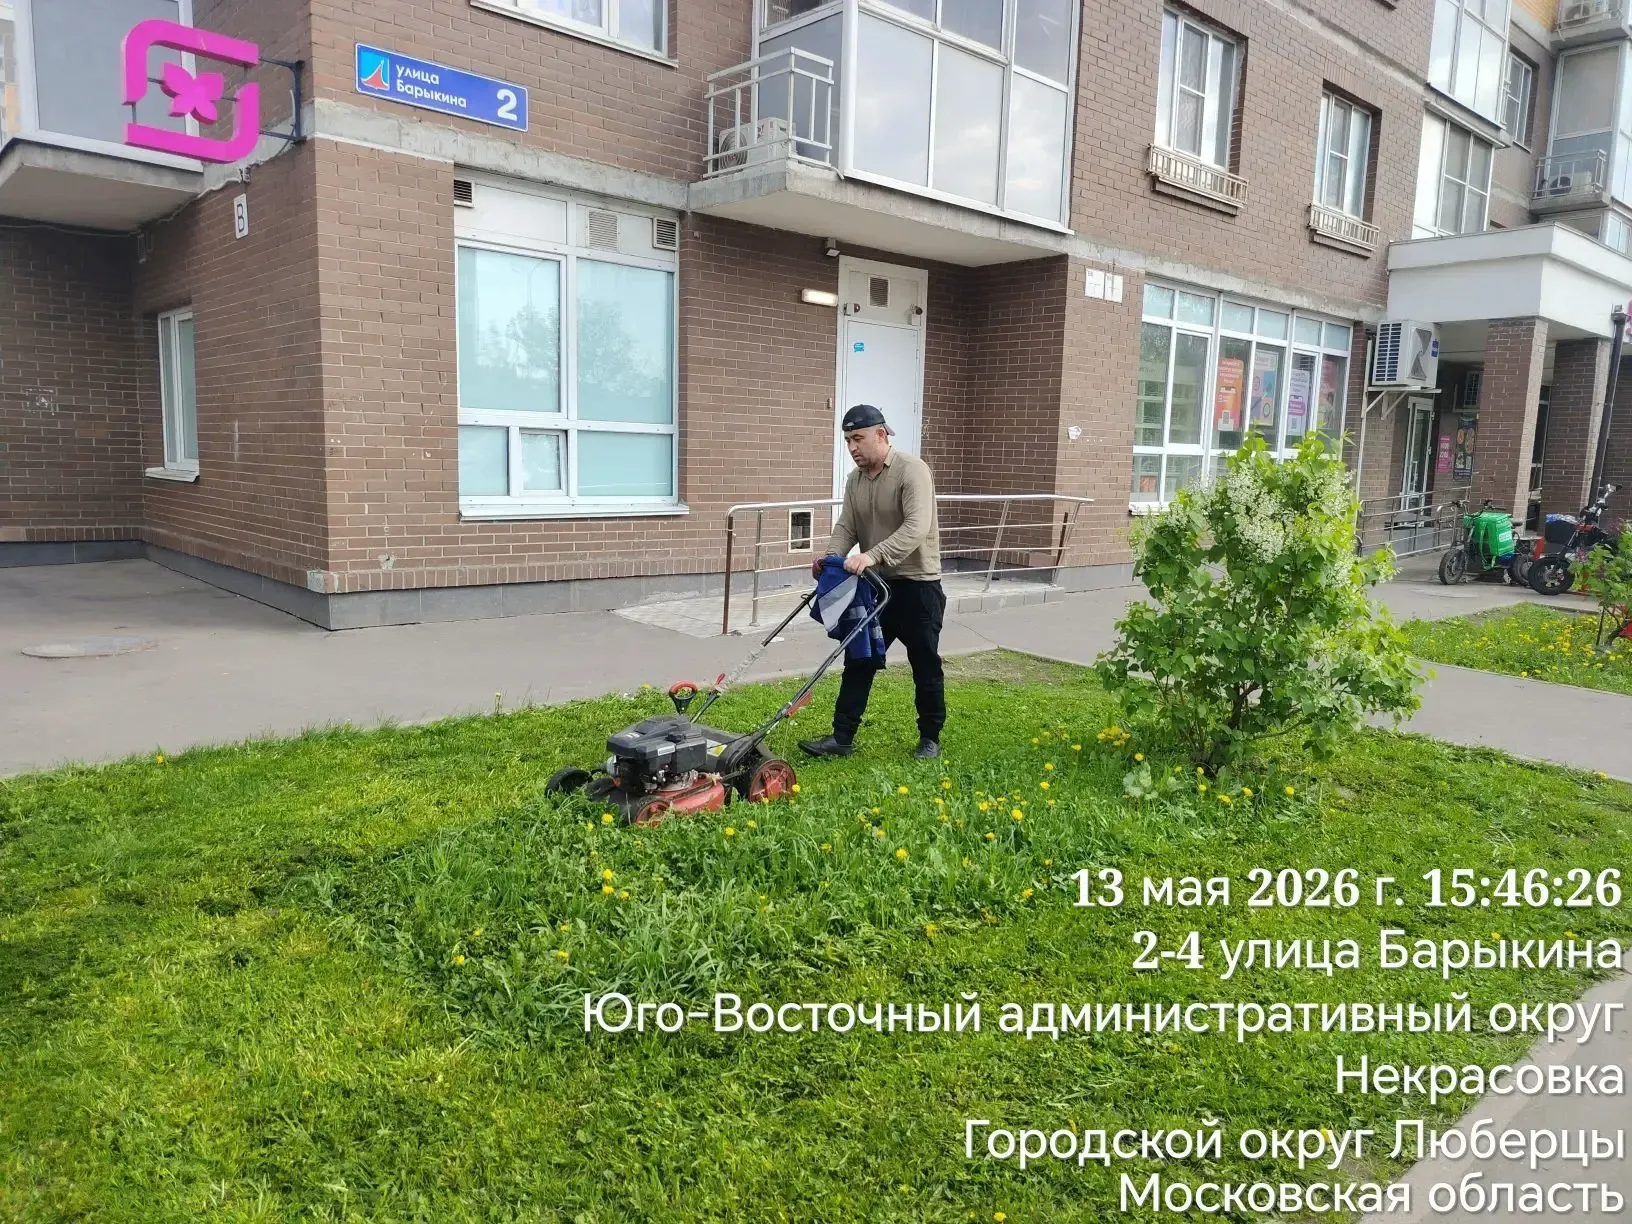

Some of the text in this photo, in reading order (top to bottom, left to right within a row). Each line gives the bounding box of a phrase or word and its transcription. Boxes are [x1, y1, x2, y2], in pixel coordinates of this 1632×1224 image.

[395, 64, 440, 85] улица
[396, 79, 467, 109] Барыкина
[496, 88, 518, 122] 2
